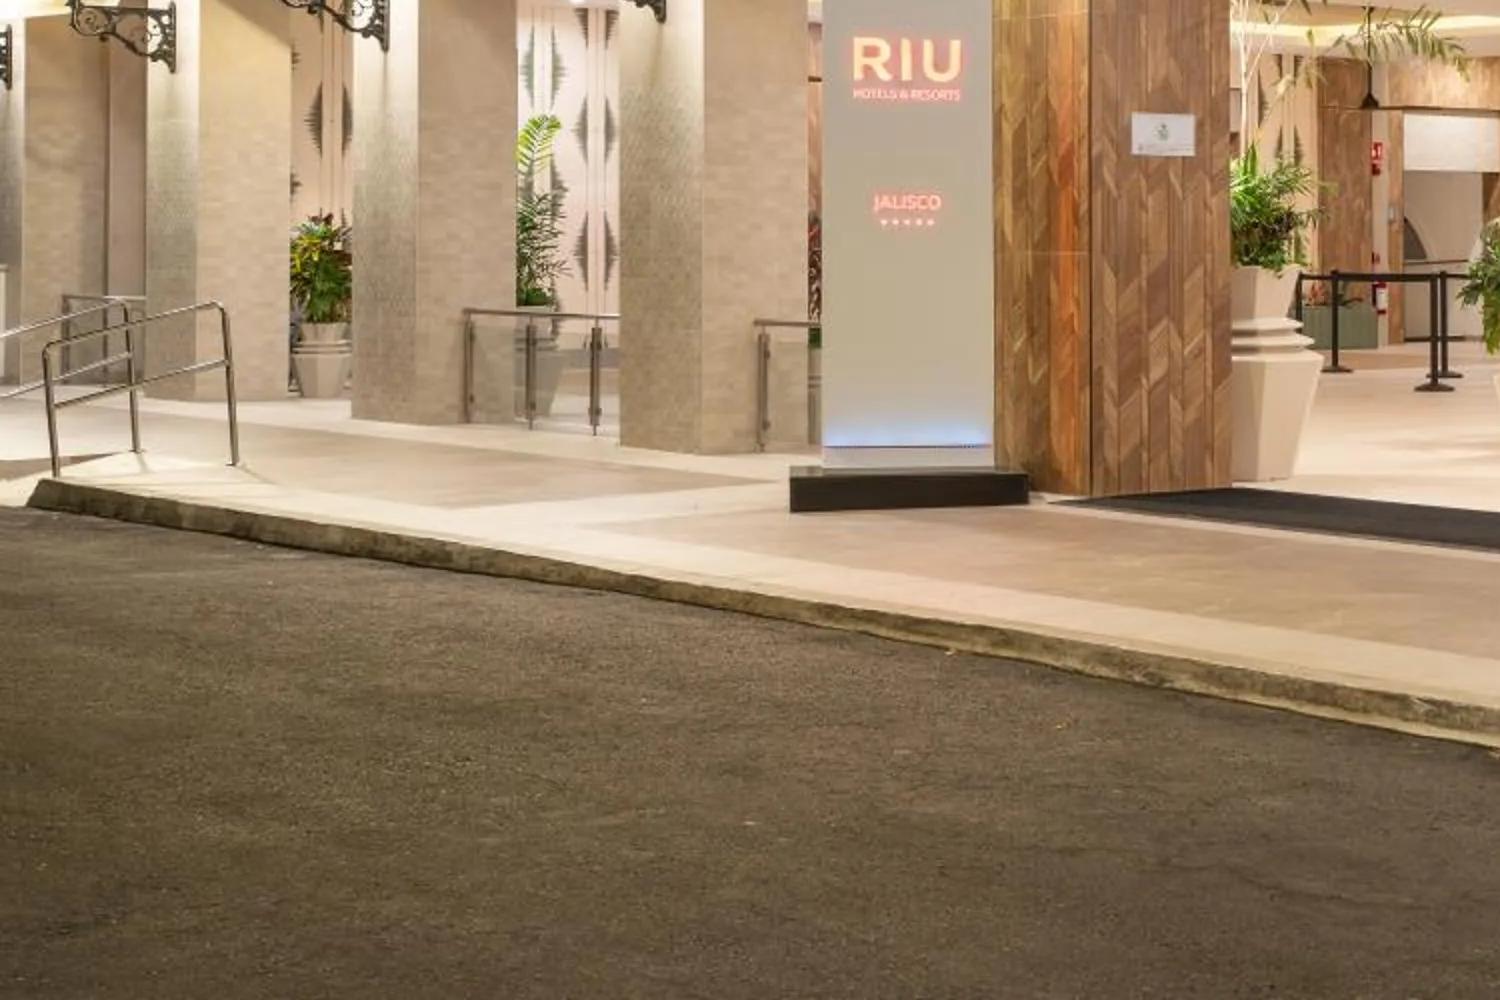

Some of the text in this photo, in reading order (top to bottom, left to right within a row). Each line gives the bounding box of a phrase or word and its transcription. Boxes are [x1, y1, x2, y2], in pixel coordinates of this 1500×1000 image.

[853, 36, 961, 83] RIU
[853, 87, 961, 102] HOTELS & RESORTS
[873, 194, 942, 212] JALISCO
